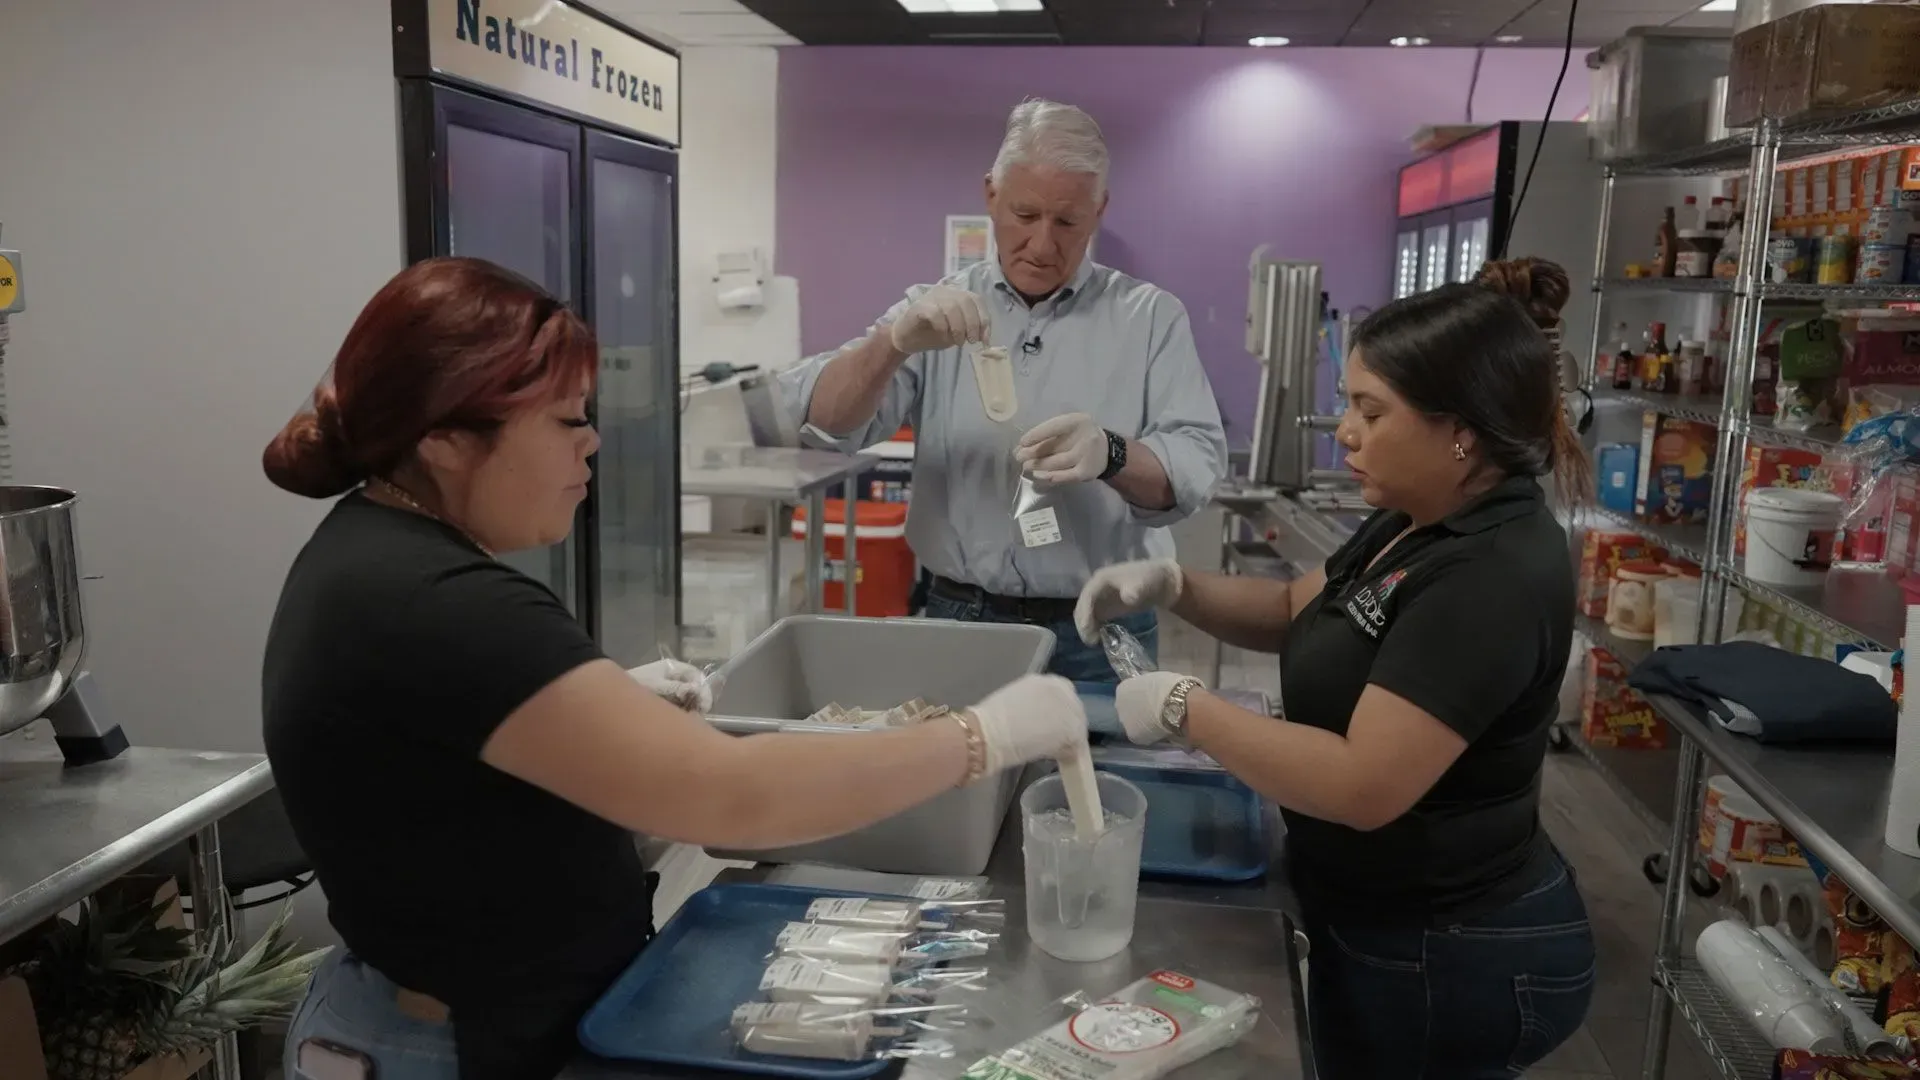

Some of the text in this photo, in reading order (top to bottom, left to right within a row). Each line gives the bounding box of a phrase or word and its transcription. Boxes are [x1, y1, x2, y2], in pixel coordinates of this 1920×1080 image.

[456, 0, 663, 111] Natural Frozen
[0, 277, 13, 286] OR
[1862, 362, 1920, 376] ALMO
